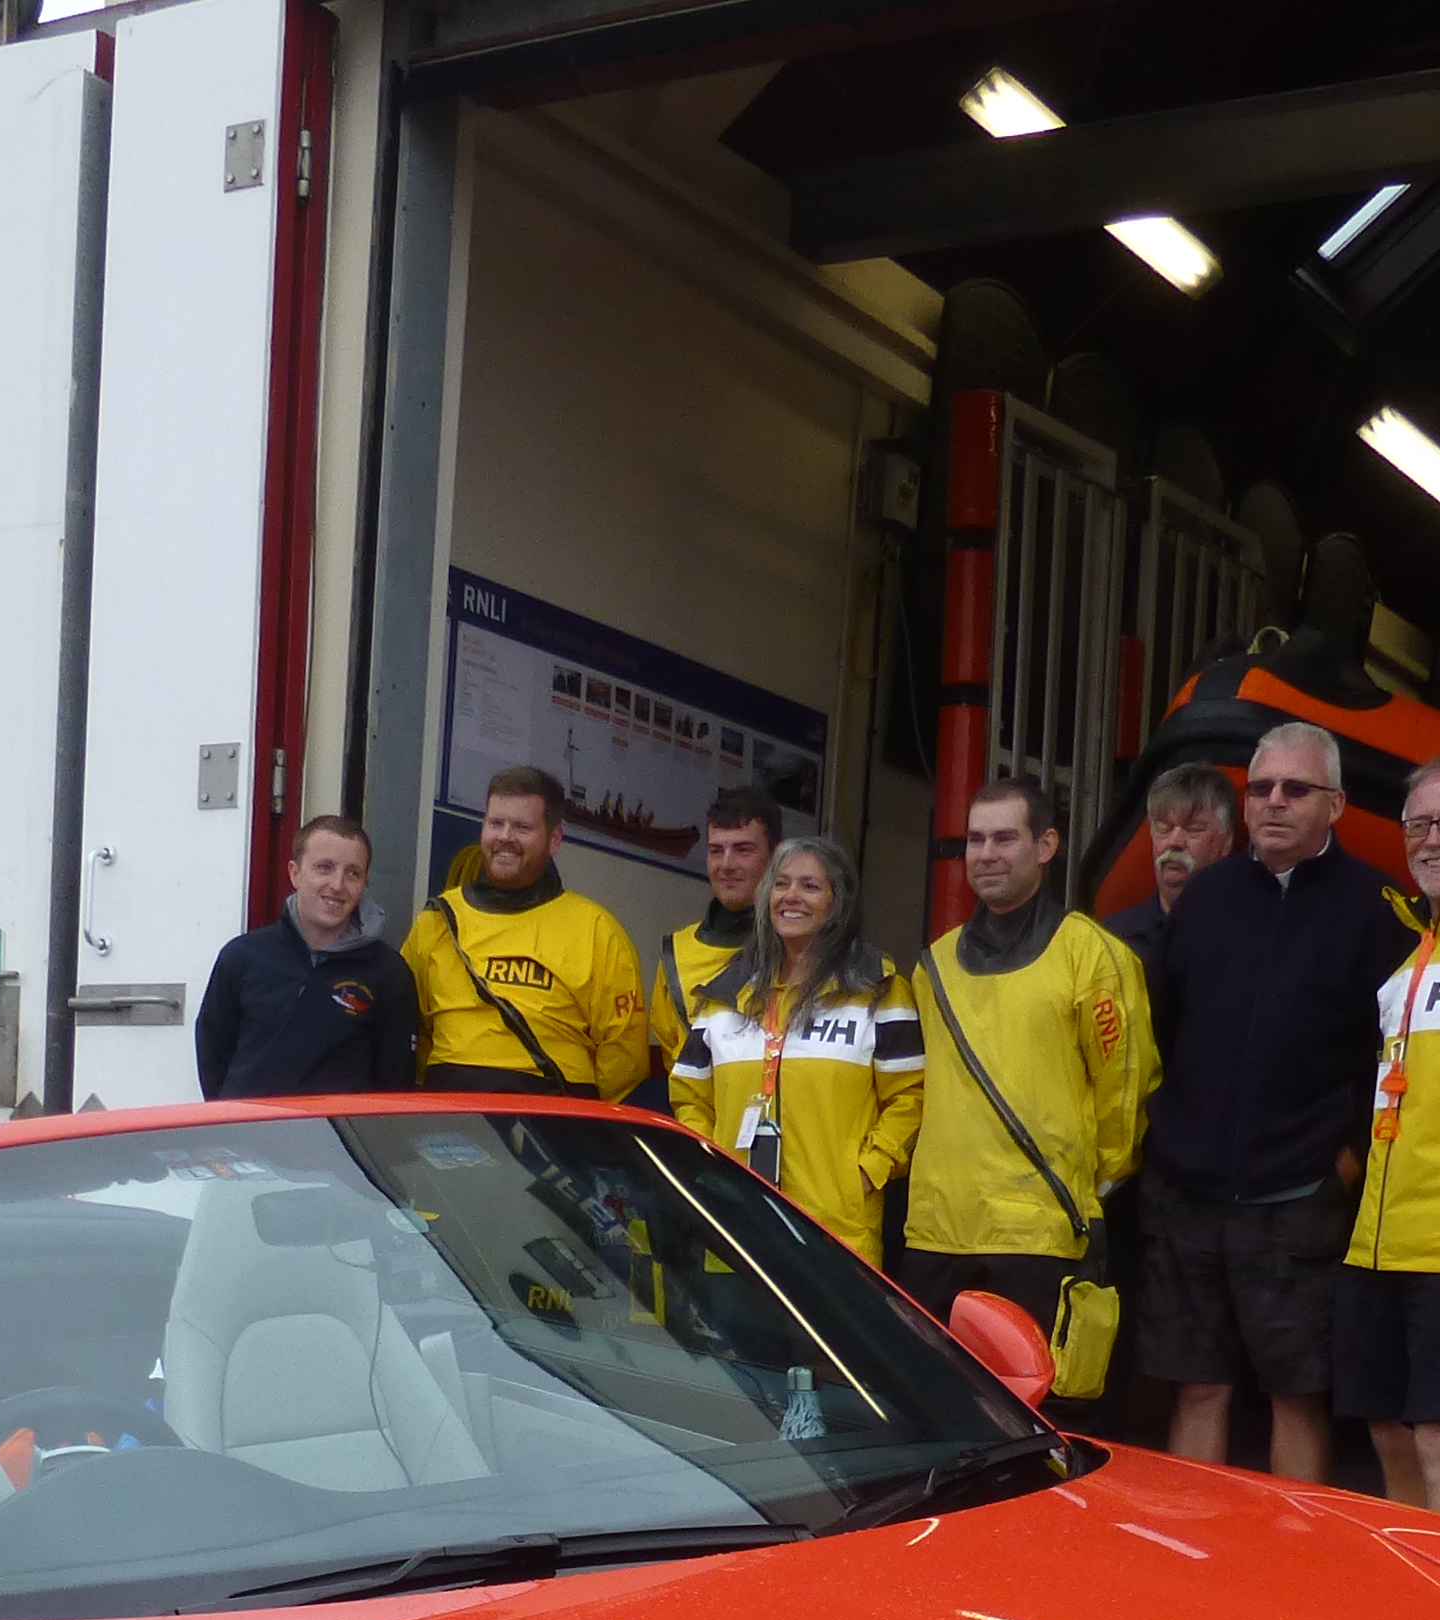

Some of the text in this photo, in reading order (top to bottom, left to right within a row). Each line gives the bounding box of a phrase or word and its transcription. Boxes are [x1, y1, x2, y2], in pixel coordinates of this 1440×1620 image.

[462, 584, 507, 623] RNLI
[489, 960, 550, 987] RNLI
[801, 1019, 857, 1046] HH
